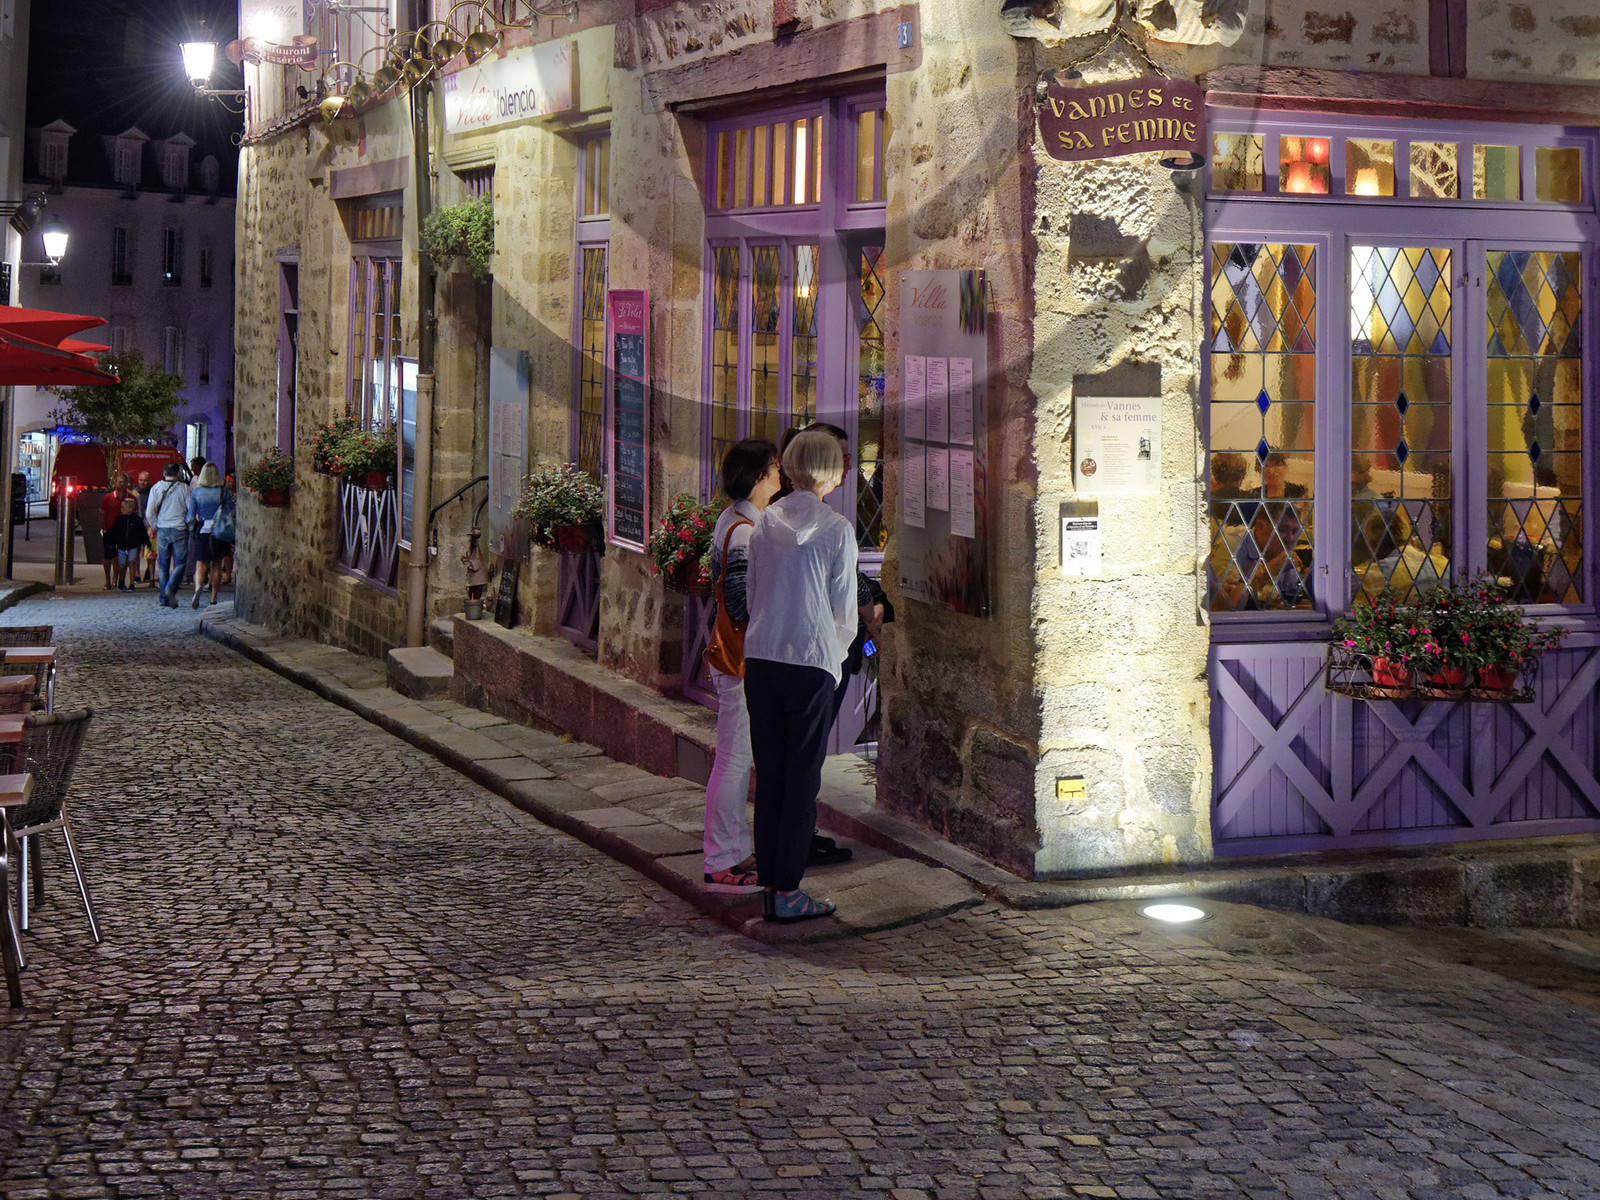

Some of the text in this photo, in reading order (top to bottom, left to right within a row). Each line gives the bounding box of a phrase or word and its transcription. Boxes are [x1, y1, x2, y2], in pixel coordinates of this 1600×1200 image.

[902, 24, 908, 45] 3
[1101, 117, 1198, 147] FEMME
[910, 278, 948, 310] Villa
[1100, 411, 1157, 422] & sa femme
[1107, 401, 1142, 411] Vannes
